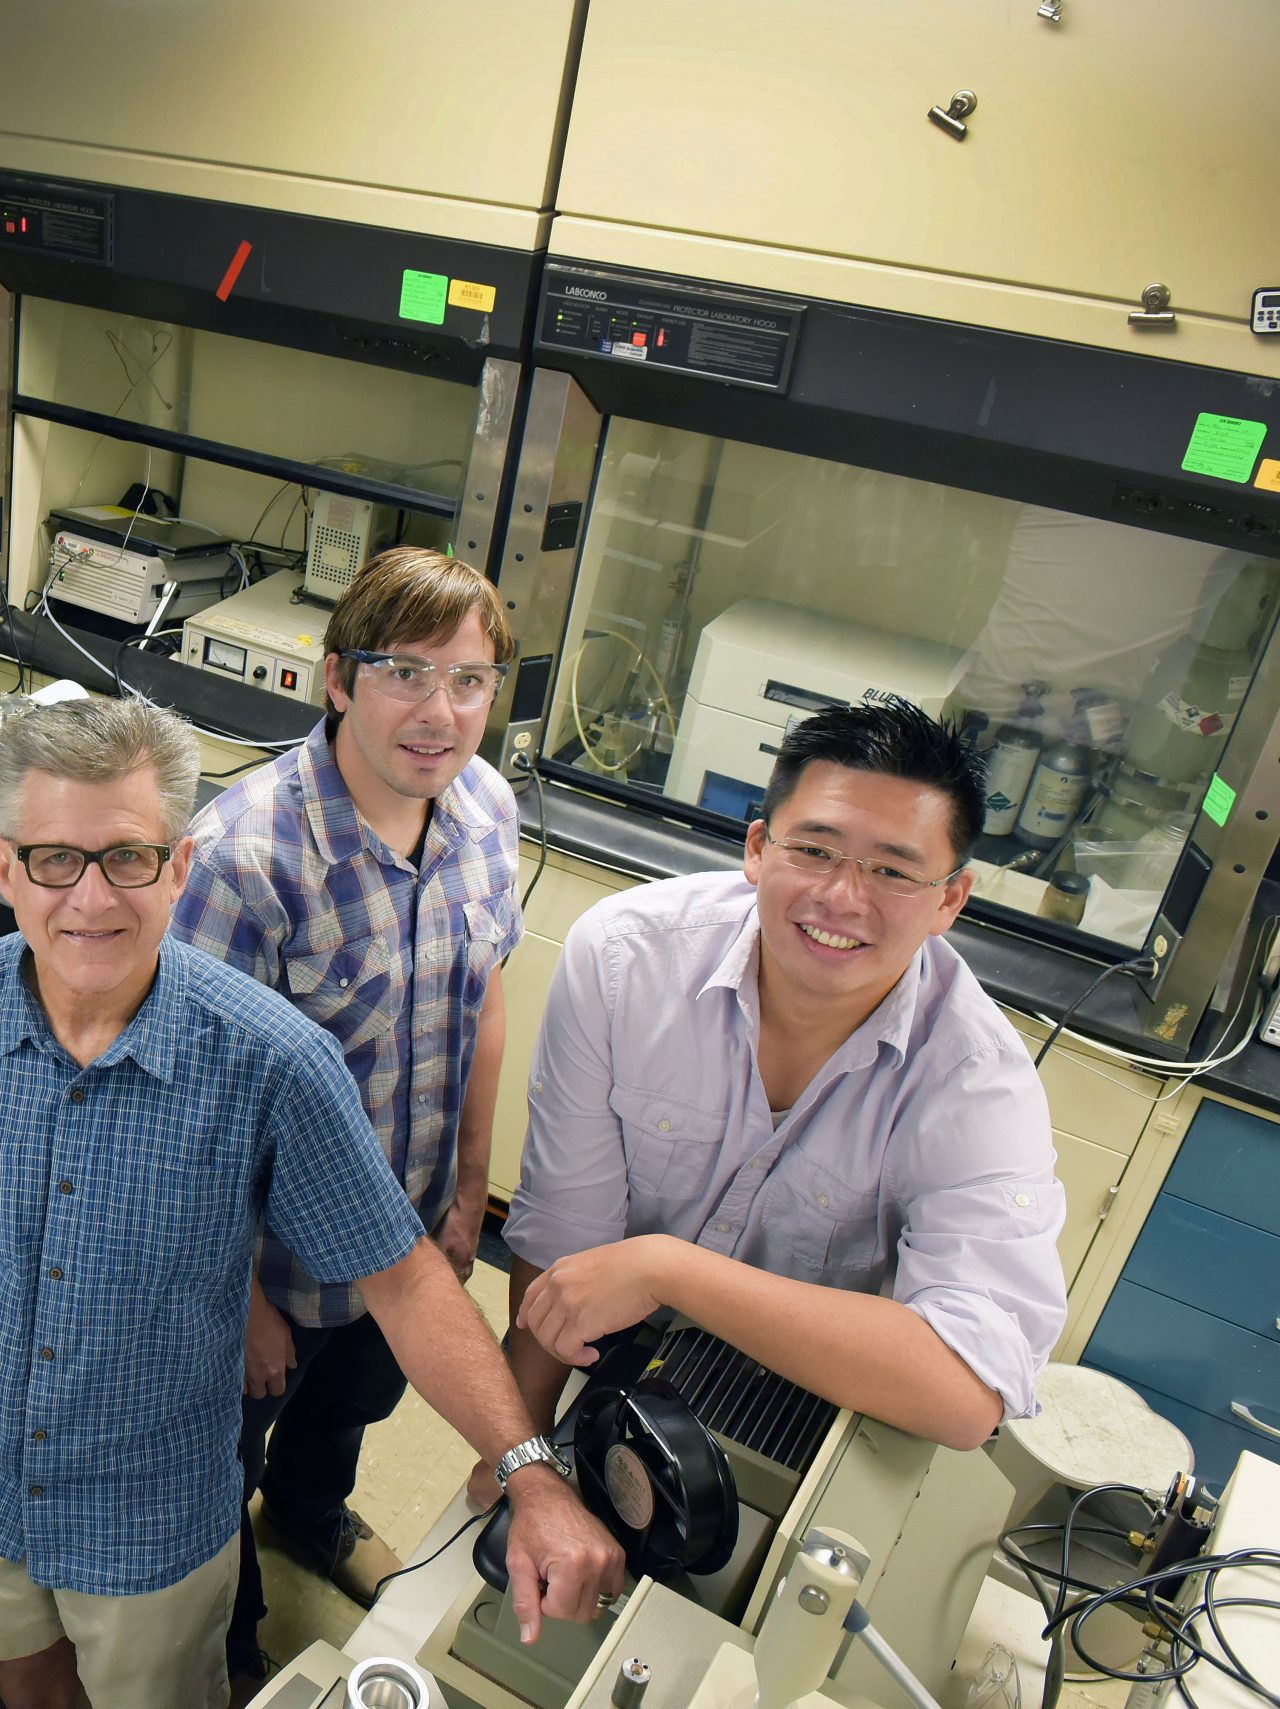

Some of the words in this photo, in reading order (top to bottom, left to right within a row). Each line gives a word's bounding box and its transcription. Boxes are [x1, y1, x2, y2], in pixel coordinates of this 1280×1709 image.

[565, 286, 607, 300] LABCONCO
[672, 305, 710, 318] PROTECTOR
[710, 311, 752, 324] LABORATORY
[754, 318, 777, 328] HOOD
